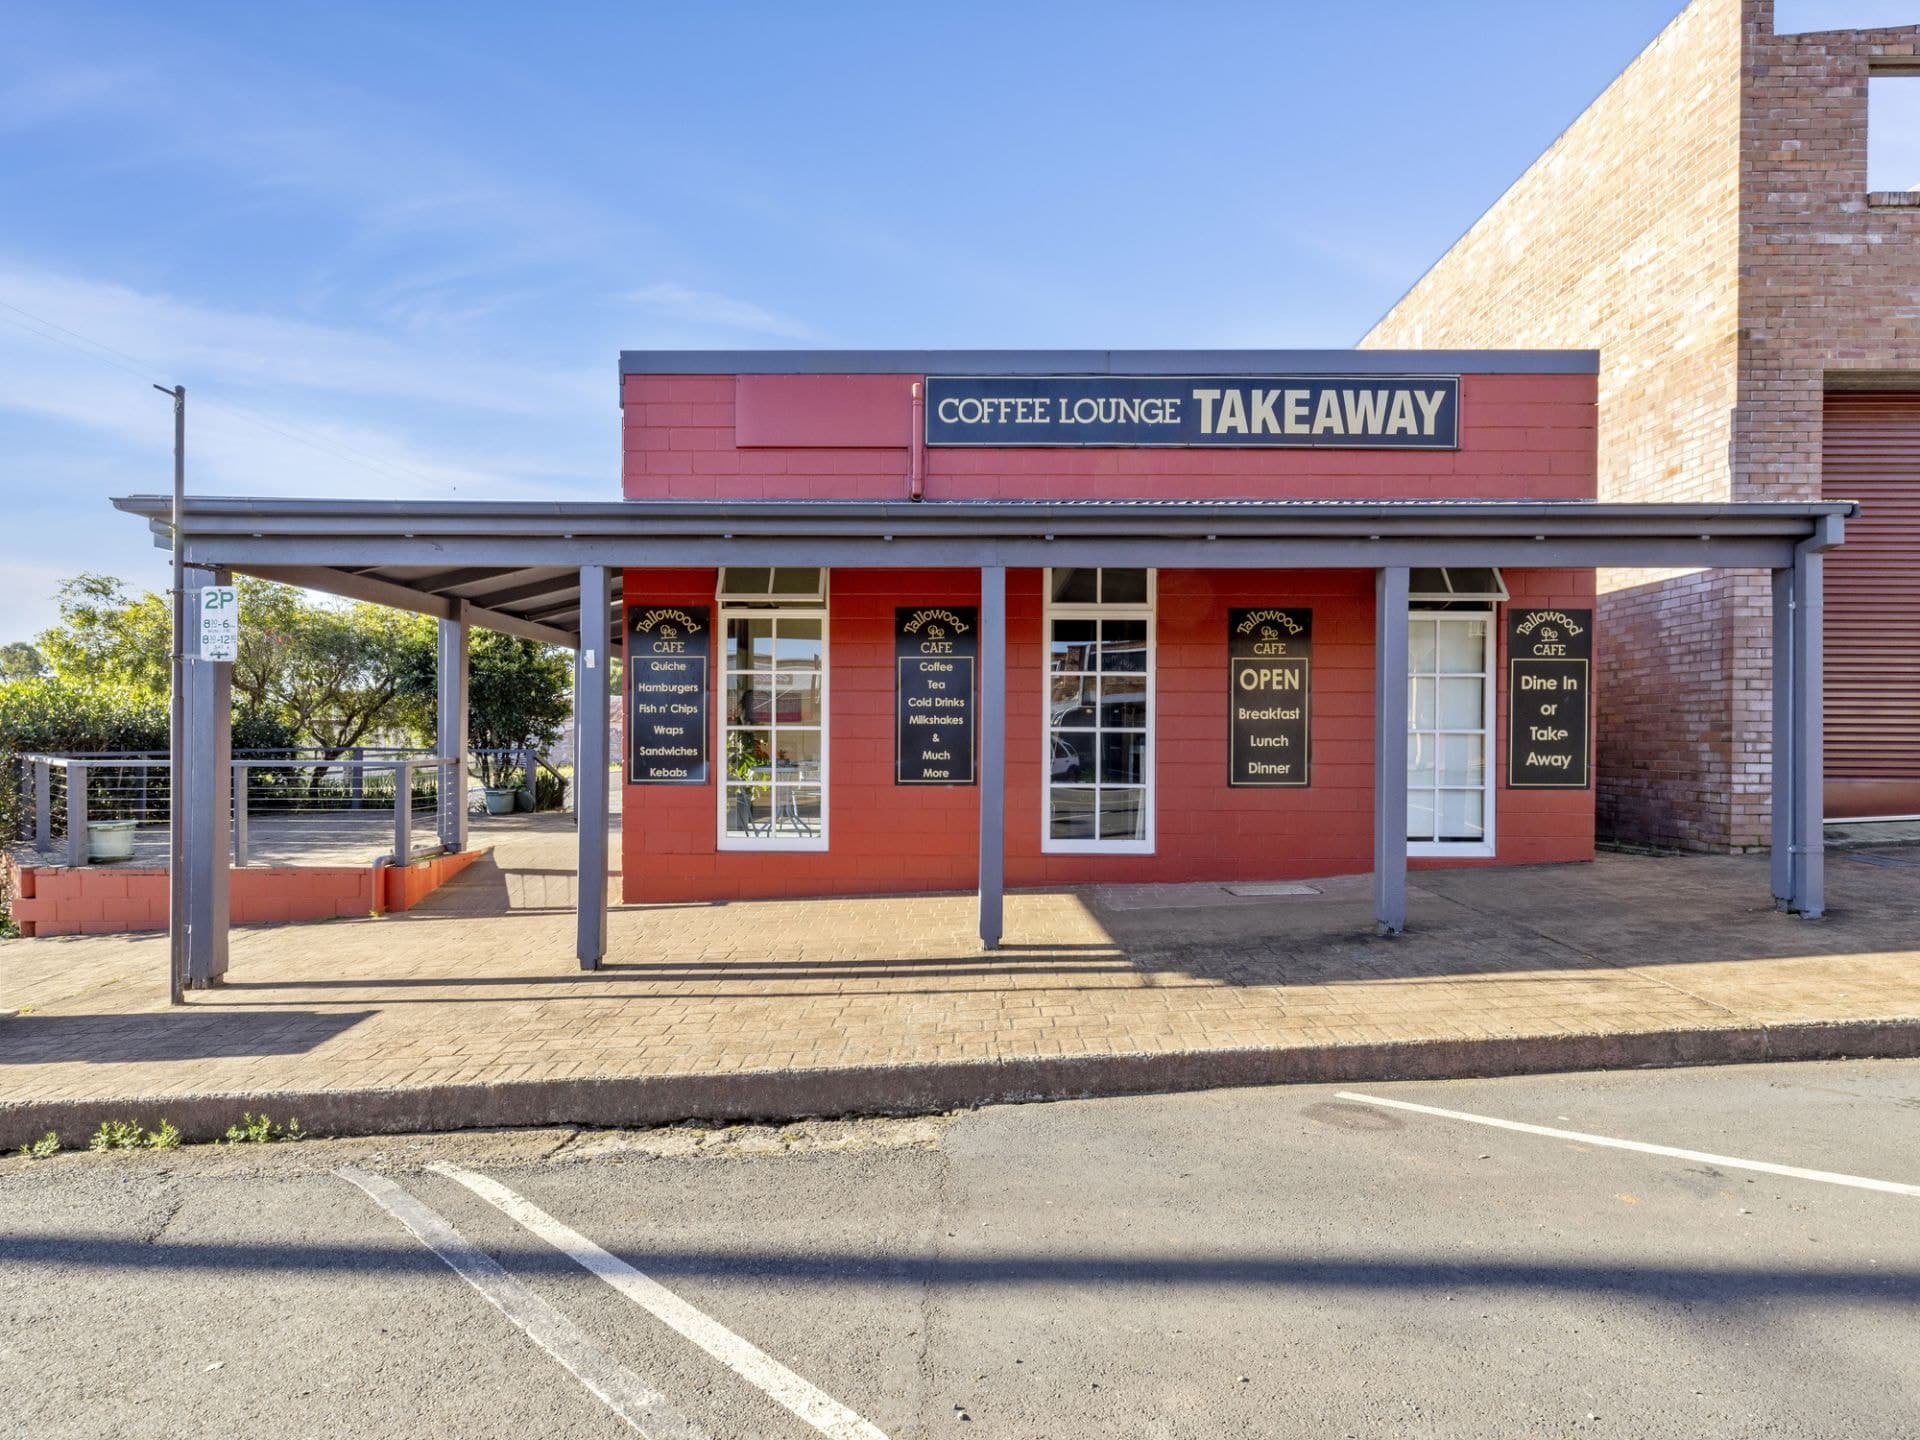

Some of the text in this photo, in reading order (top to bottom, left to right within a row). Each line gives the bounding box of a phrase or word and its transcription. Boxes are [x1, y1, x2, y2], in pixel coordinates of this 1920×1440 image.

[938, 389, 1446, 436] COFFEE LOUNGE TAKEAWAY
[205, 592, 234, 609] 2P
[636, 609, 701, 633] Tallowood
[904, 609, 969, 634] Tallowood
[1237, 610, 1303, 635] Tallowood
[1516, 611, 1584, 636] Tallowood
[653, 642, 685, 653] CAFE
[920, 642, 952, 653] CAFE
[1254, 643, 1286, 654] CAFE
[1533, 645, 1566, 656] CAFE
[651, 662, 686, 671] Quiche
[920, 662, 953, 672] Coffee
[928, 680, 945, 689] Tea
[1240, 668, 1300, 690] OPEN
[1521, 675, 1577, 690] Dine In
[639, 683, 698, 694] Hamburgers
[908, 698, 964, 707] Cold Drinks
[639, 704, 697, 715] Fish n' Chips
[1239, 708, 1300, 720] Breakfast
[1540, 704, 1557, 716] or
[909, 716, 964, 725] Milkshakes
[654, 725, 683, 736] Wraps
[1530, 726, 1568, 741] Take
[932, 734, 939, 742] &
[1250, 735, 1288, 746] Lunch
[640, 747, 697, 756] Sandwiches
[922, 751, 950, 760] Much
[1526, 752, 1572, 769] Away
[650, 768, 687, 777] Kebabs
[923, 769, 949, 778] More
[1249, 762, 1290, 774] Dinner
